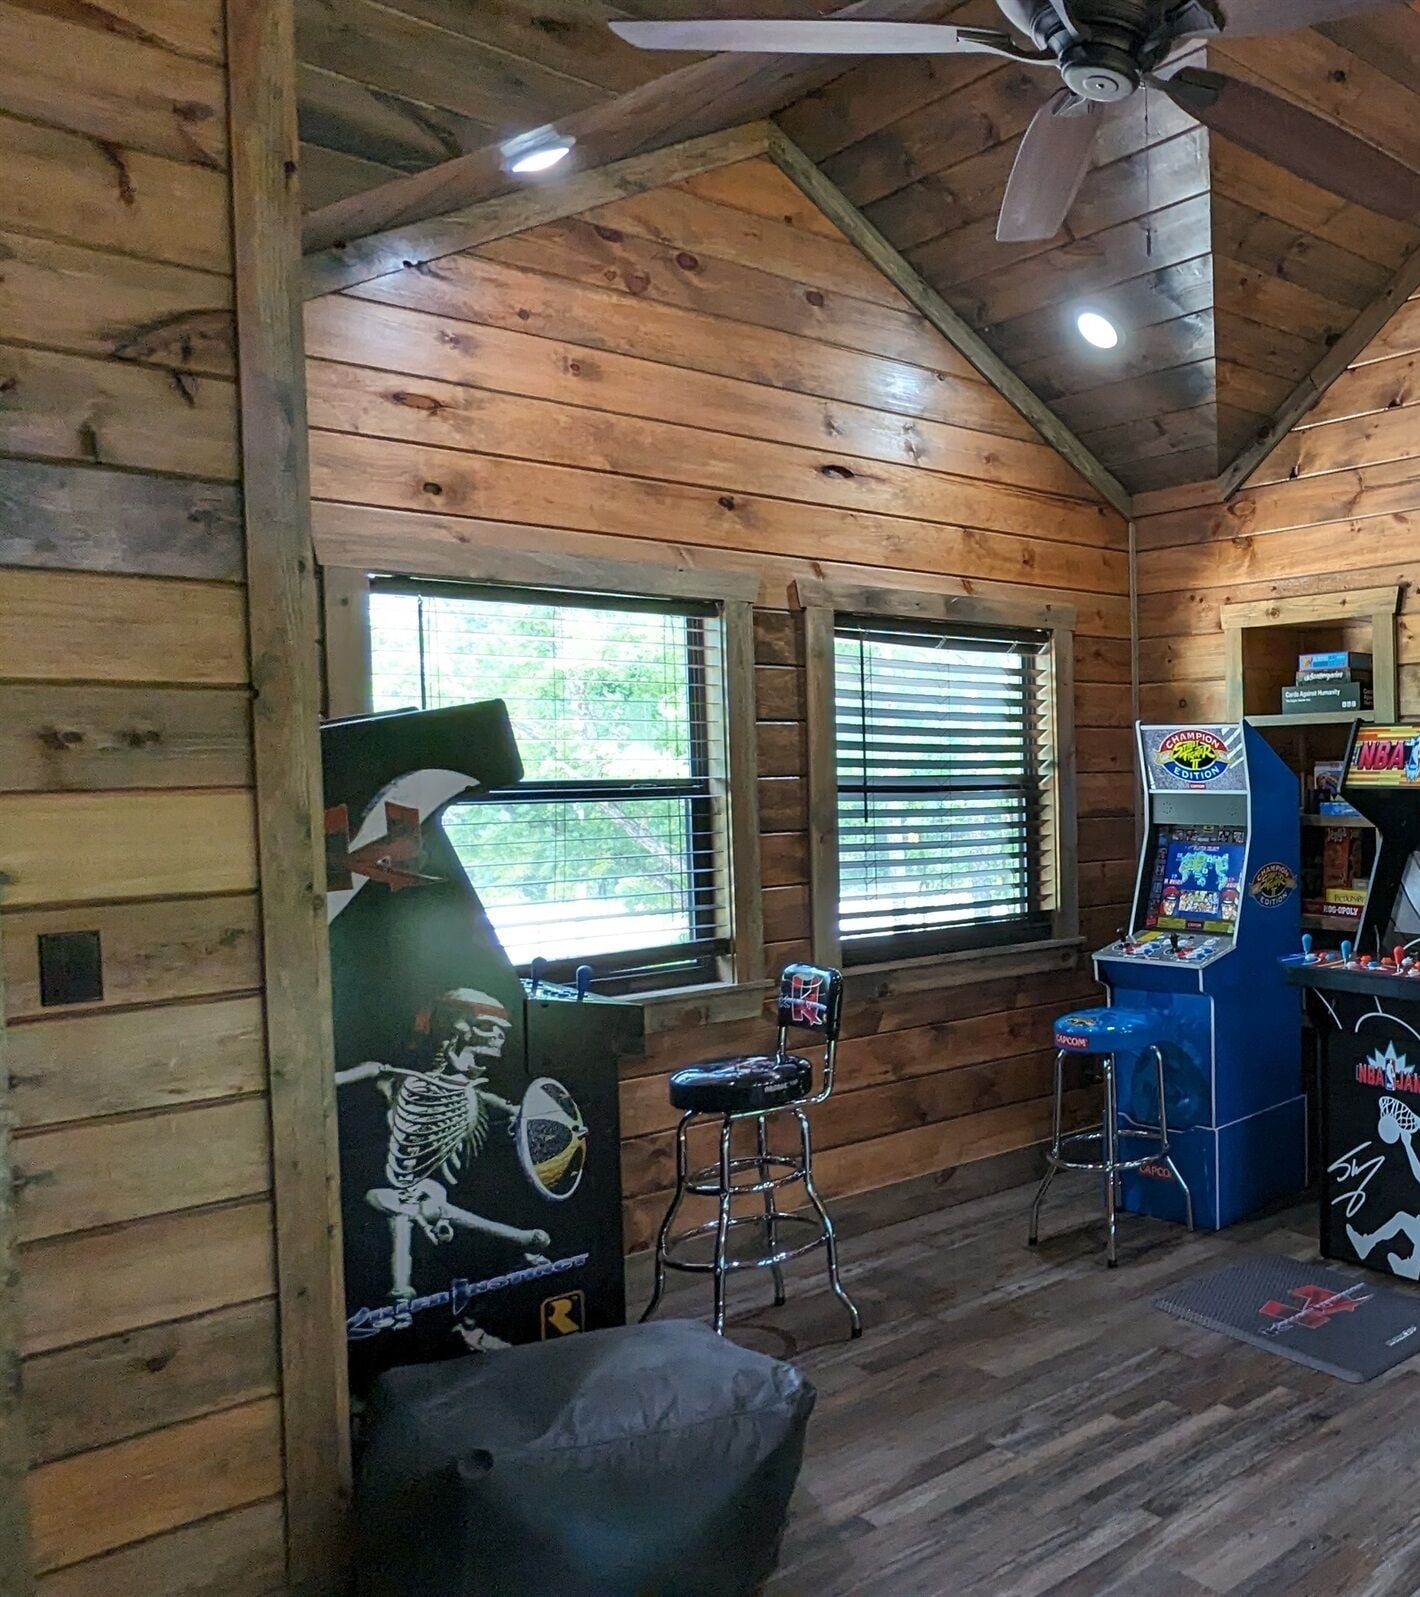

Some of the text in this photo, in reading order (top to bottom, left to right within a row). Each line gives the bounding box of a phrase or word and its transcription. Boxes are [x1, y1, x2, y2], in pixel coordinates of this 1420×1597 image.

[1300, 690, 1317, 698] Against
[1318, 688, 1340, 697] Humanity
[1166, 731, 1219, 749] CHAMPION
[1357, 739, 1404, 770] NBA
[1174, 766, 1219, 780] EDITION
[1056, 1033, 1088, 1048] CAPCOM
[1357, 1062, 1384, 1088] NBA
